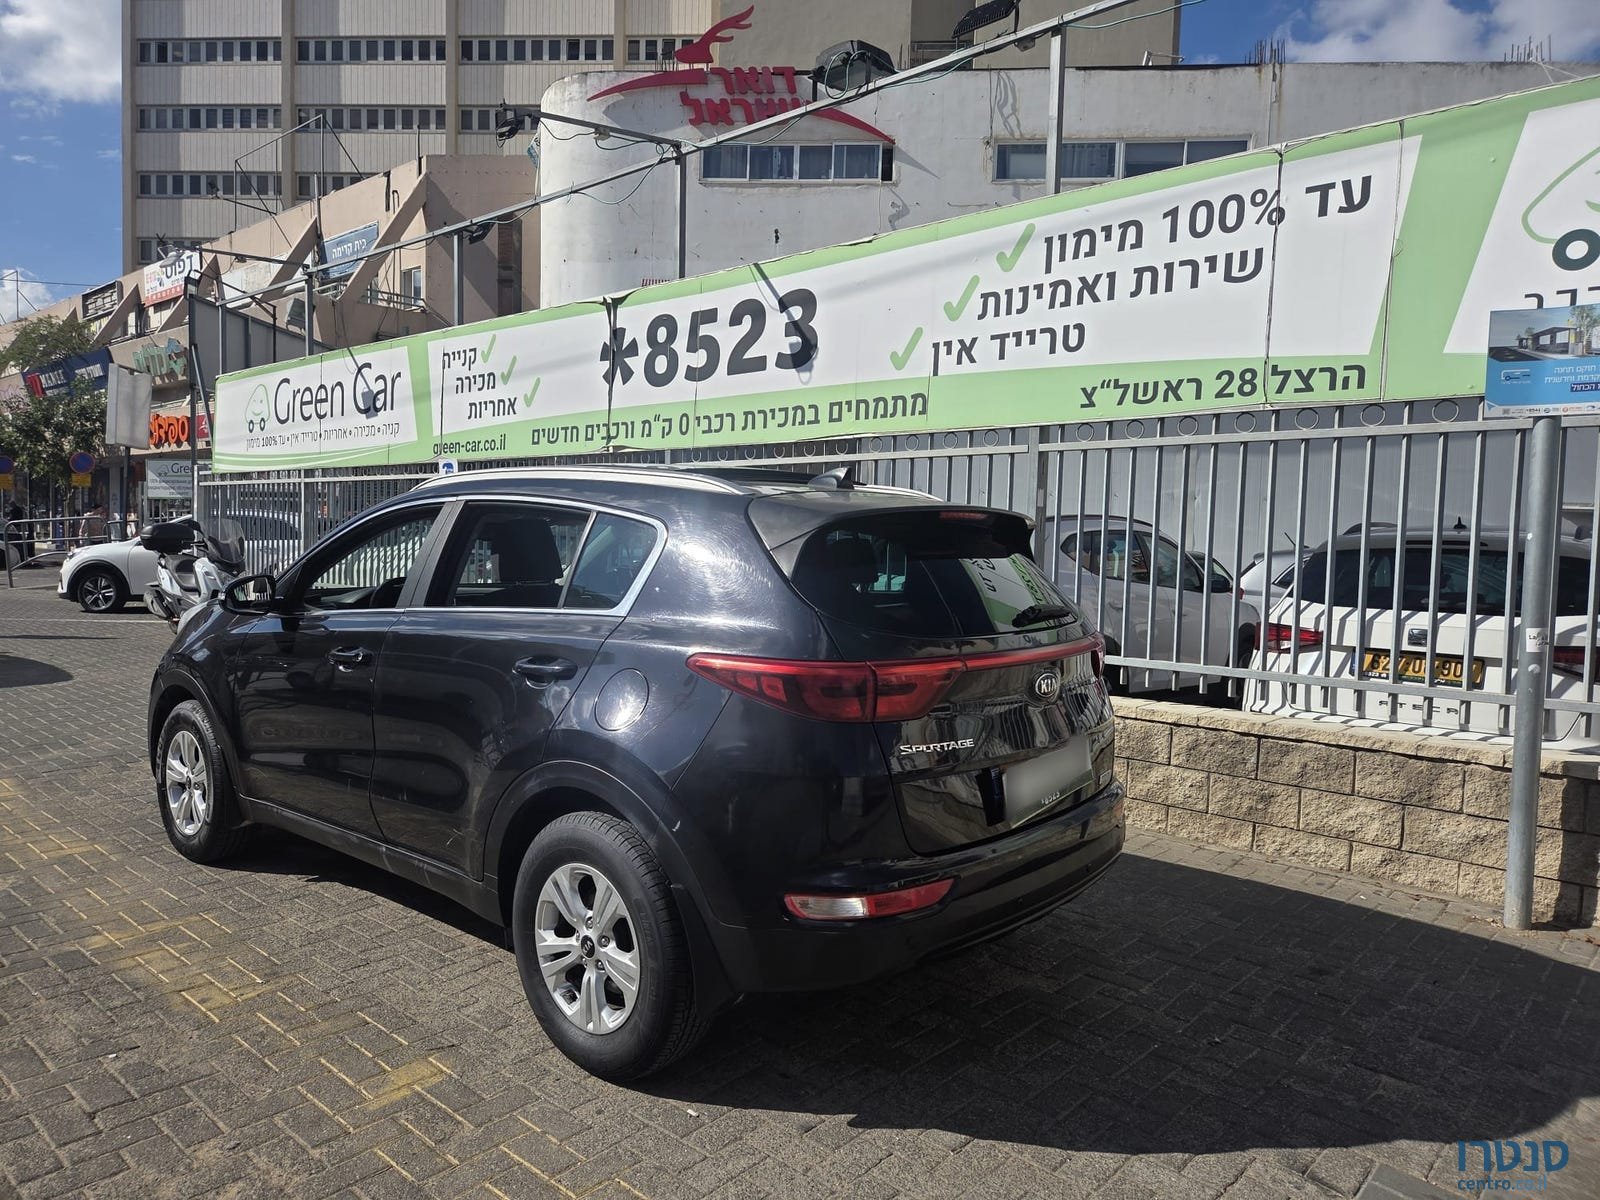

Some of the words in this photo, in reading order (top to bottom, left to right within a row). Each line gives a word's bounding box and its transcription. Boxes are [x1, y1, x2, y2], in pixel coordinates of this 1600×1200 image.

[710, 66, 796, 95] דואר
[1304, 175, 1372, 217] עד
[1162, 188, 1286, 244] 100%
[1043, 218, 1144, 274] מימון
[1129, 246, 1264, 299] שירות
[977, 271, 1116, 320] ואמינות
[931, 335, 979, 377] אין
[990, 322, 1086, 361] טרייד
[274, 377, 345, 425] Green
[353, 361, 401, 415] Car
[455, 372, 496, 394] מכירה
[1215, 368, 1259, 399] 28
[1268, 364, 1366, 395] הרצל
[467, 396, 517, 420] אחריות
[743, 403, 821, 433] במכירת
[828, 392, 928, 424] מתמחים
[323, 428, 348, 441] אחריות
[353, 424, 376, 437] מכירה
[381, 422, 400, 437] קניה
[531, 425, 580, 446] חדשים
[678, 411, 690, 436] 0
[696, 411, 735, 435] רכבי
[261, 435, 277, 447] 100%
[171, 462, 193, 474] Gre
[1040, 677, 1057, 693] KIA
[899, 738, 975, 755] SPORTAGE
